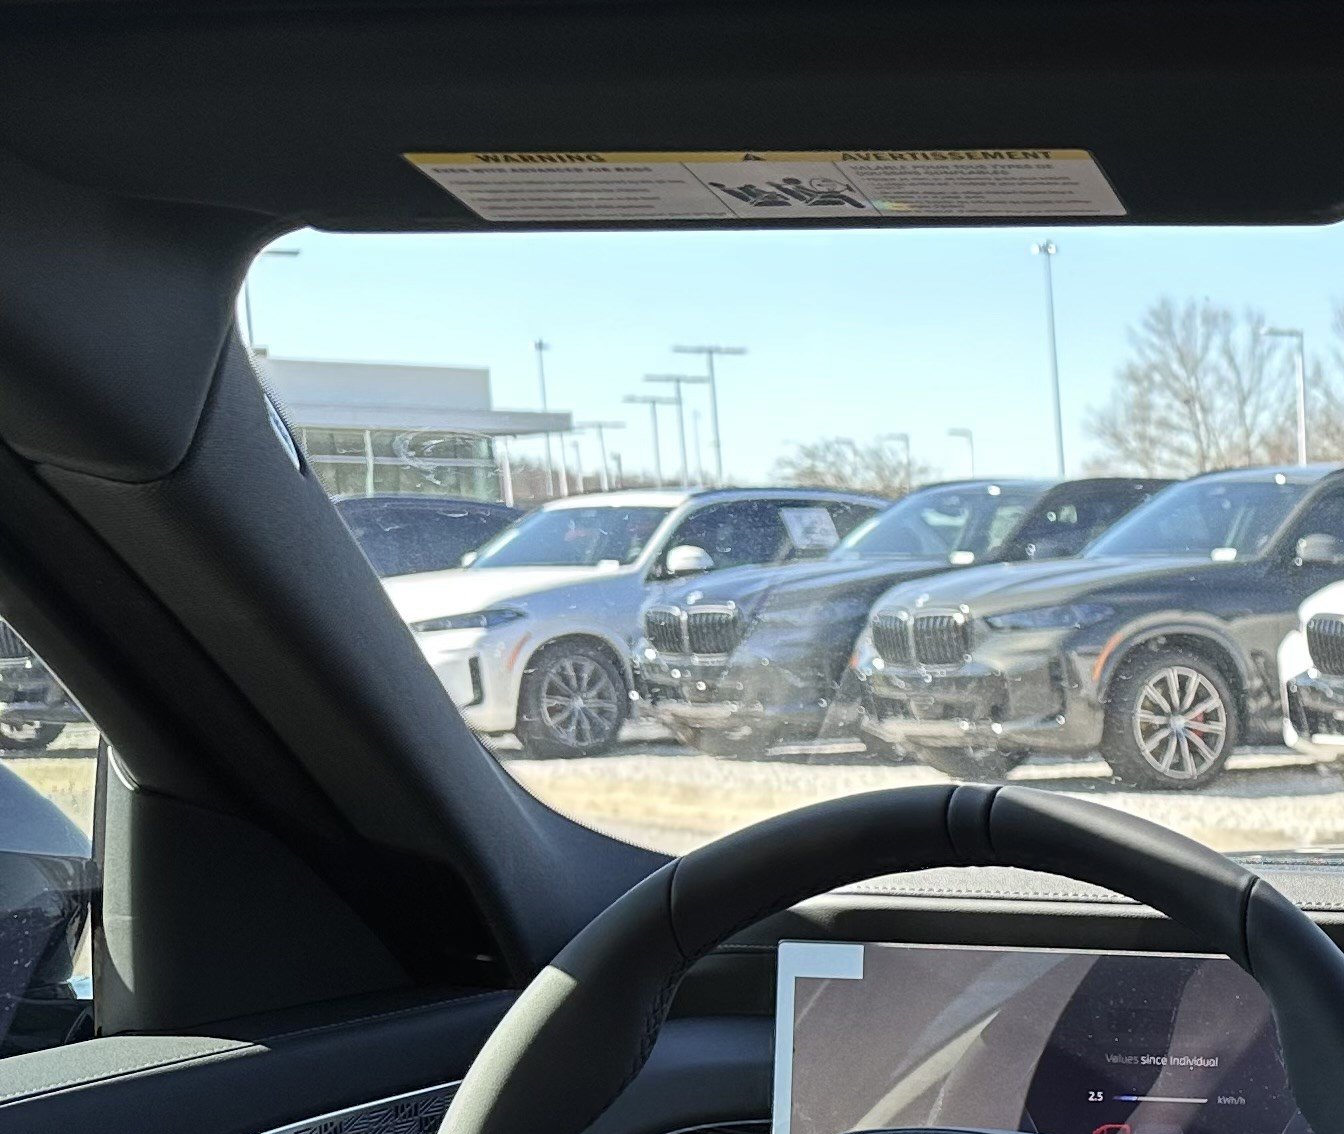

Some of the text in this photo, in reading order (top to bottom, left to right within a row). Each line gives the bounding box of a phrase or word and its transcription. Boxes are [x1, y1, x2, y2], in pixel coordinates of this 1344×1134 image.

[474, 153, 607, 163] WARNING
[841, 151, 1052, 161] AVERTISSEMENT
[1104, 1053, 1219, 1067] Values since Individual
[1088, 1091, 1104, 1102] 2.5
